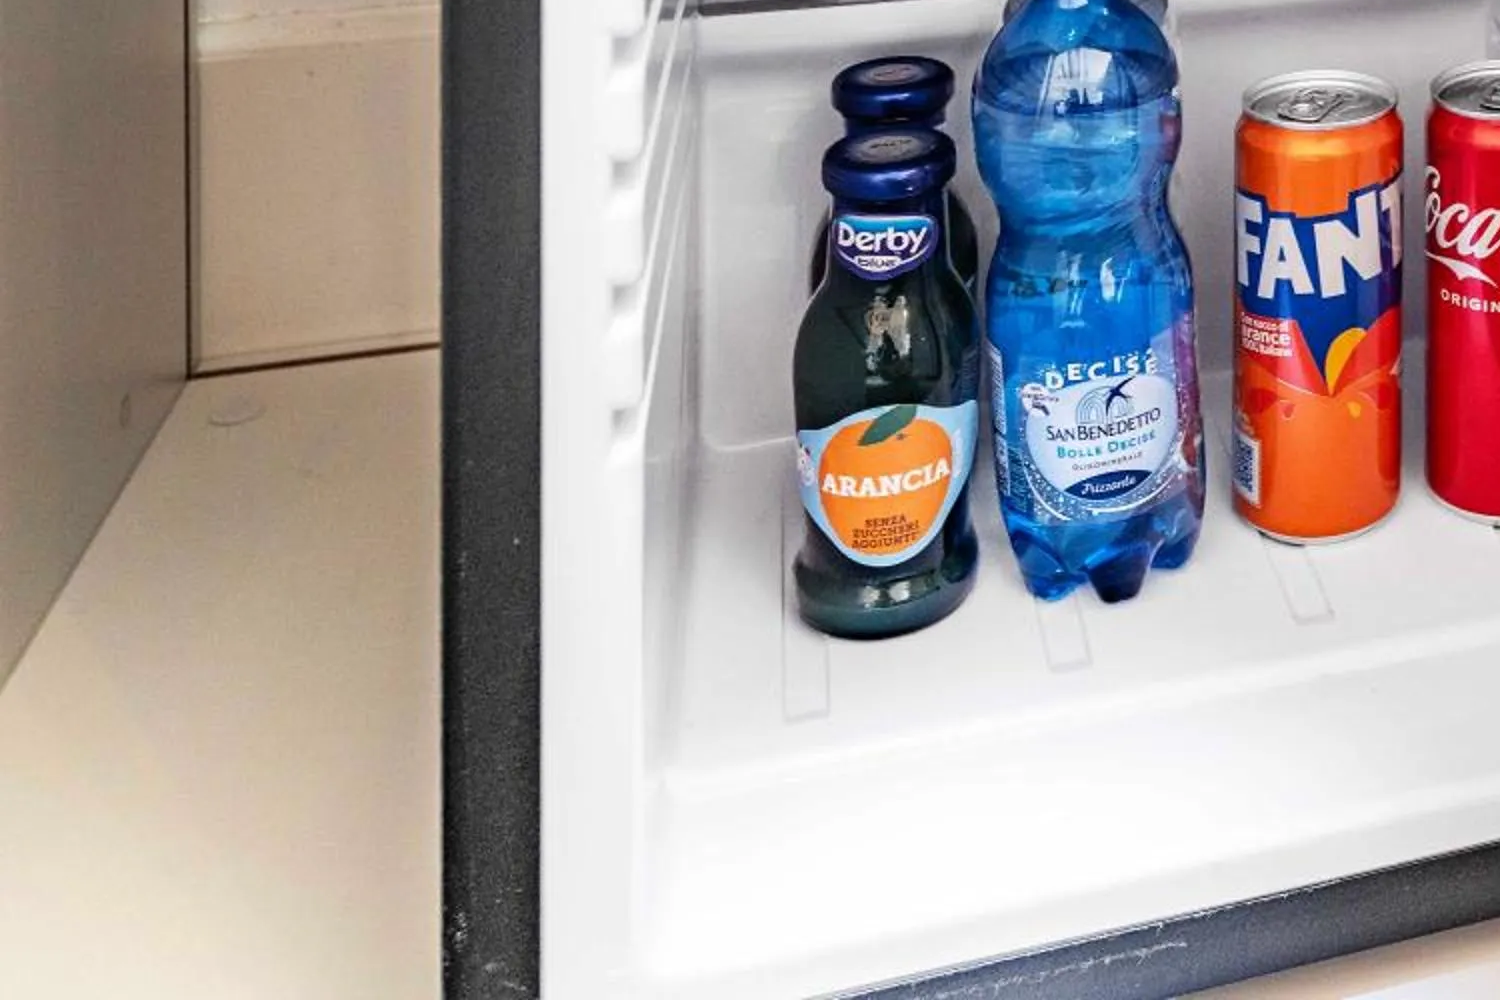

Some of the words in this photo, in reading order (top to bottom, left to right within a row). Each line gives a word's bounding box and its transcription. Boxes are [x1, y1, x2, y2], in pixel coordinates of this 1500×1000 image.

[838, 221, 927, 253] Derby
[1237, 181, 1400, 299] FANT
[1057, 445, 1101, 459] BOLLE
[822, 457, 950, 497] ARANCIA
[852, 520, 919, 538] ZUCCHERI
[865, 514, 906, 528] SENZA
